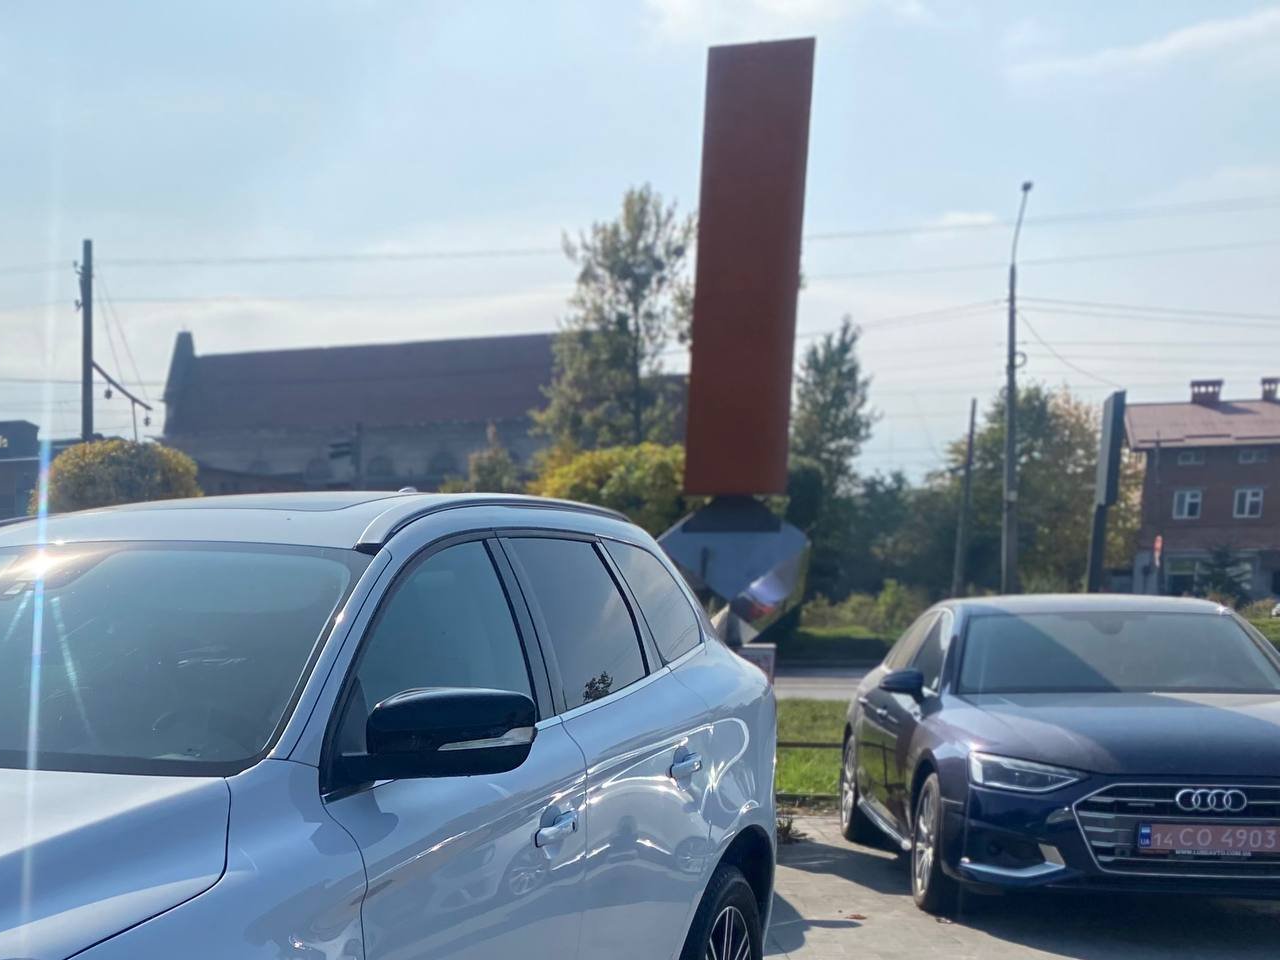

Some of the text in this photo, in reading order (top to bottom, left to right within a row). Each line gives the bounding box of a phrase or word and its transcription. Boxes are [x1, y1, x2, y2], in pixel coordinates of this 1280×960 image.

[1153, 828, 1276, 848] 14 CO 4903
